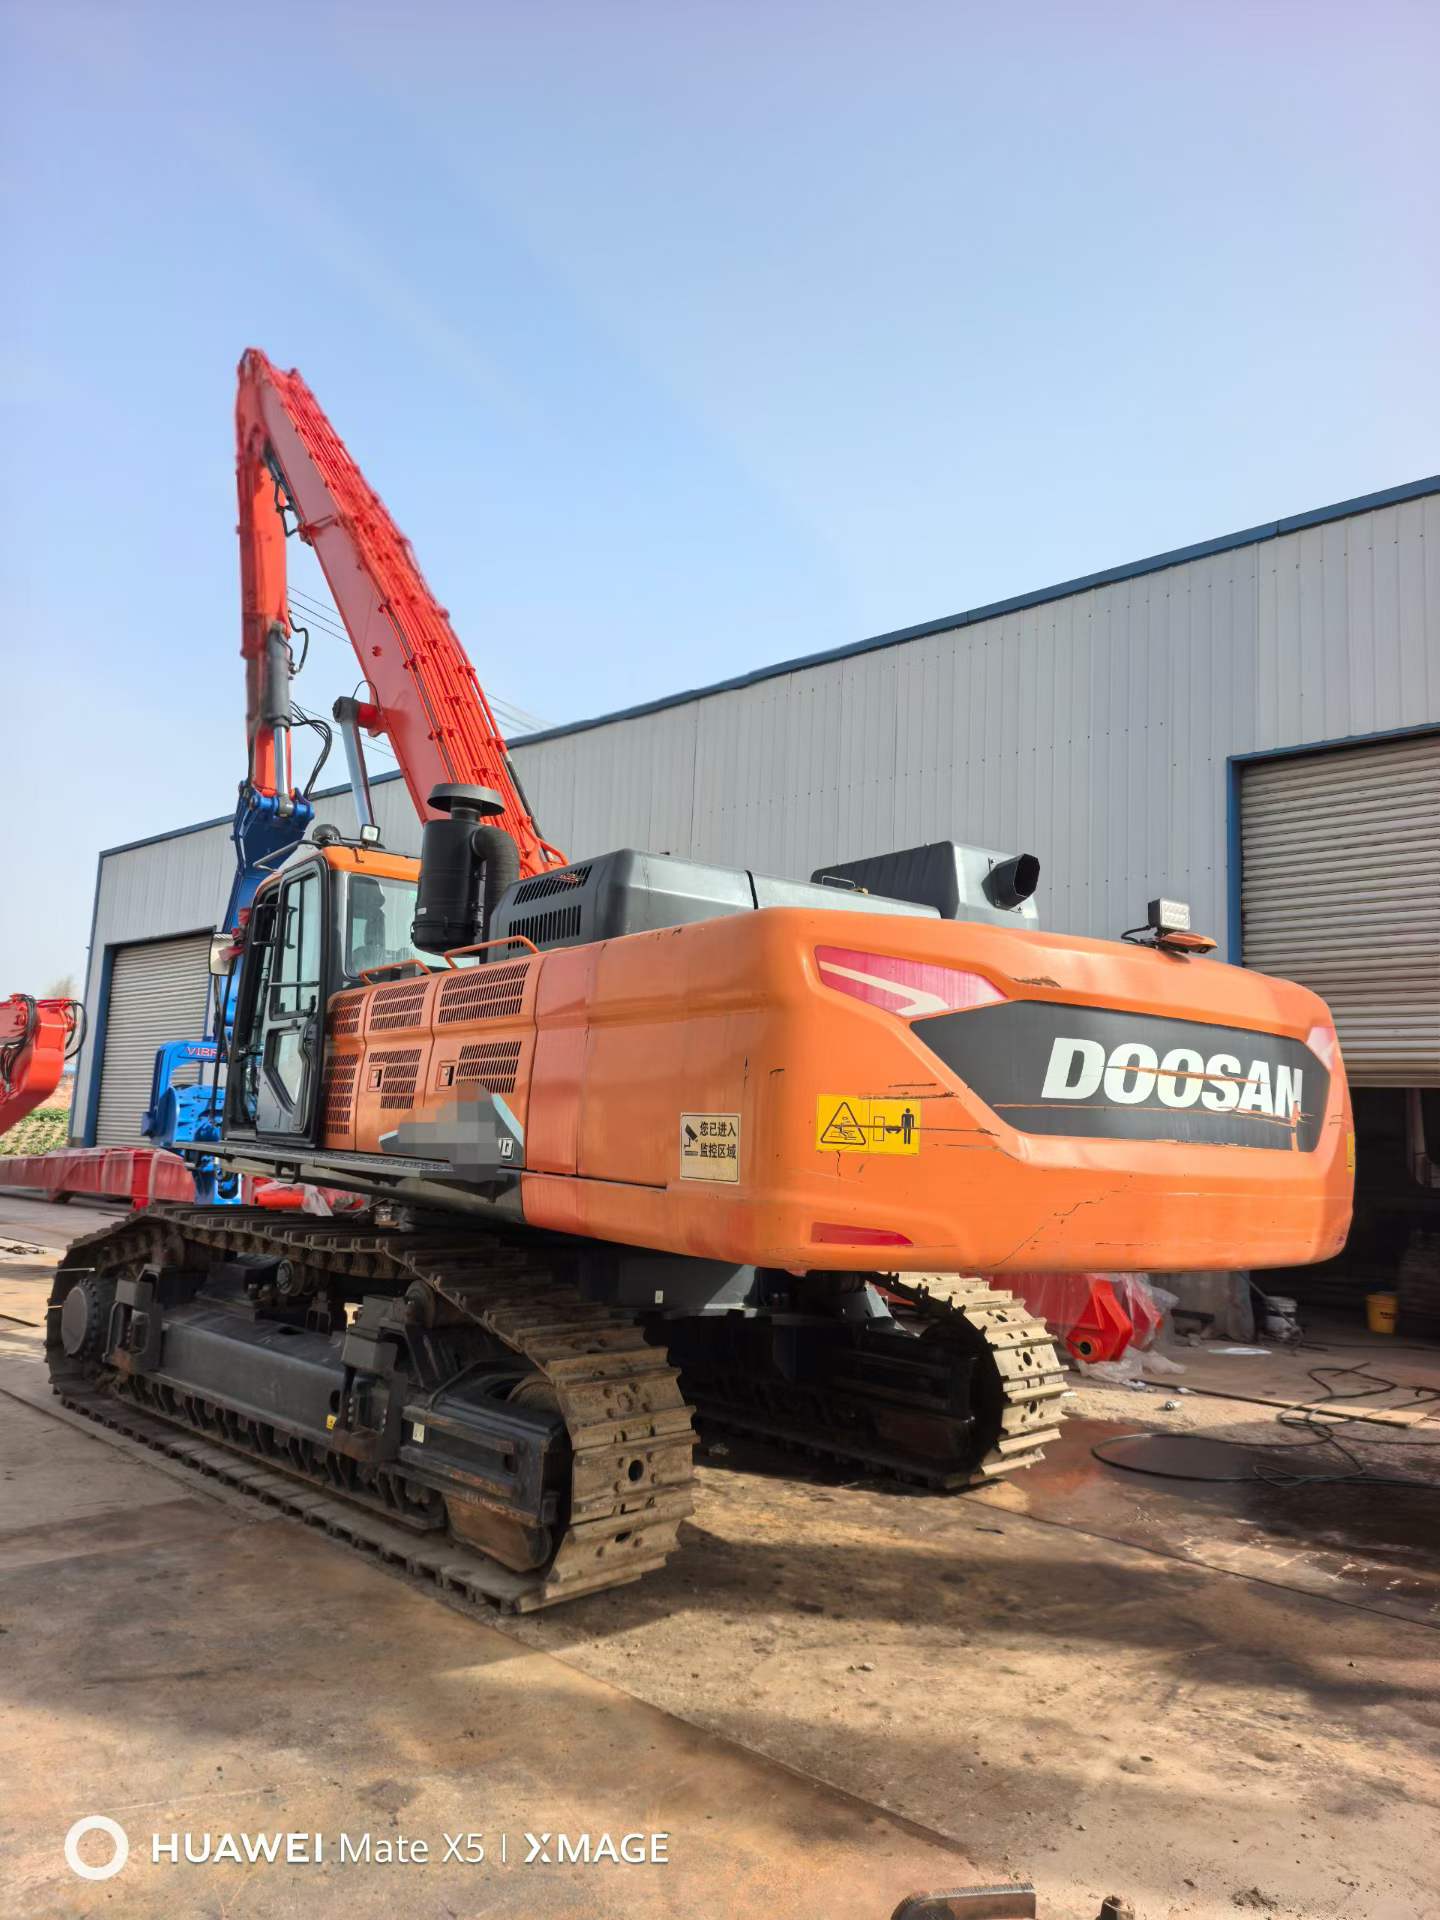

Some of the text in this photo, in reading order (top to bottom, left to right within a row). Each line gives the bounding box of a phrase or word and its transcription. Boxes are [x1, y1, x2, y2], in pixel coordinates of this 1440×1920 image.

[1041, 1037, 1303, 1118] DOOSAN
[699, 1121, 737, 1137] 您已进入
[699, 1143, 737, 1159] 监控区域
